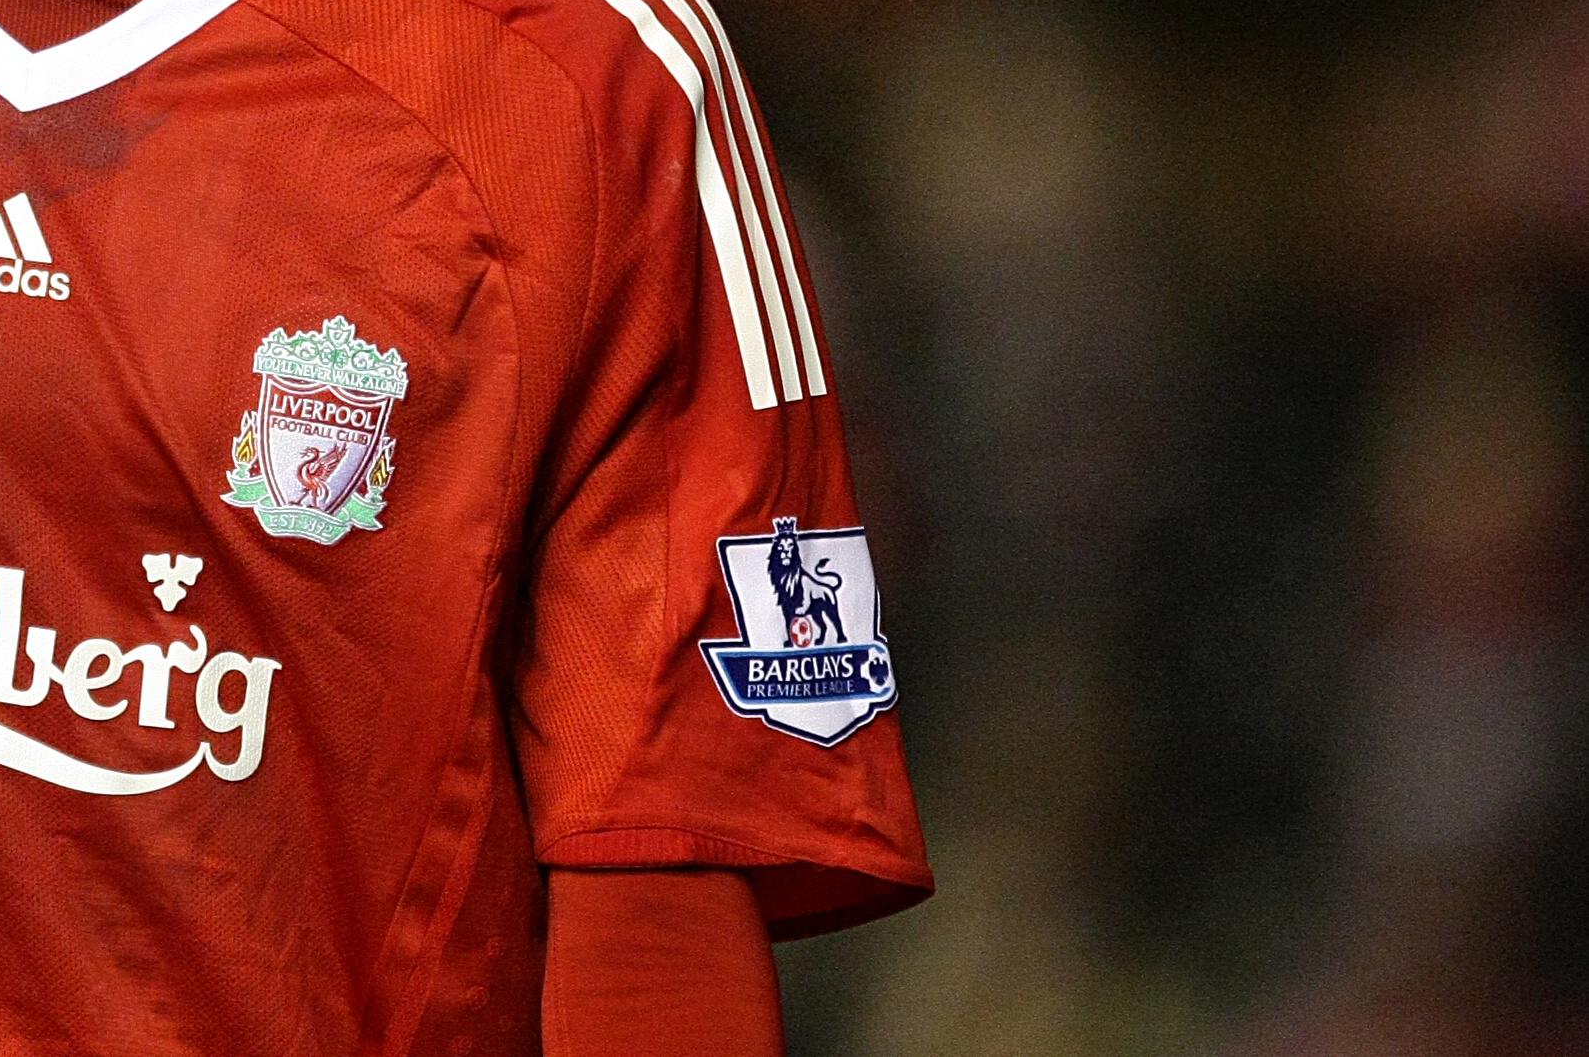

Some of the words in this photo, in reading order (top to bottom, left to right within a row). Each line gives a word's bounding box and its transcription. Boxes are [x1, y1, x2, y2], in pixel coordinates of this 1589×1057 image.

[295, 364, 331, 381] NEVER
[332, 369, 365, 388] WALK
[365, 377, 405, 393] ALONE
[270, 394, 376, 430] LIVERPOOL
[271, 417, 333, 440] FOOTBALL
[336, 430, 369, 446] CLUB
[270, 514, 298, 529] EST
[748, 654, 854, 682] BARCLAYS
[747, 683, 812, 698] PREMIER
